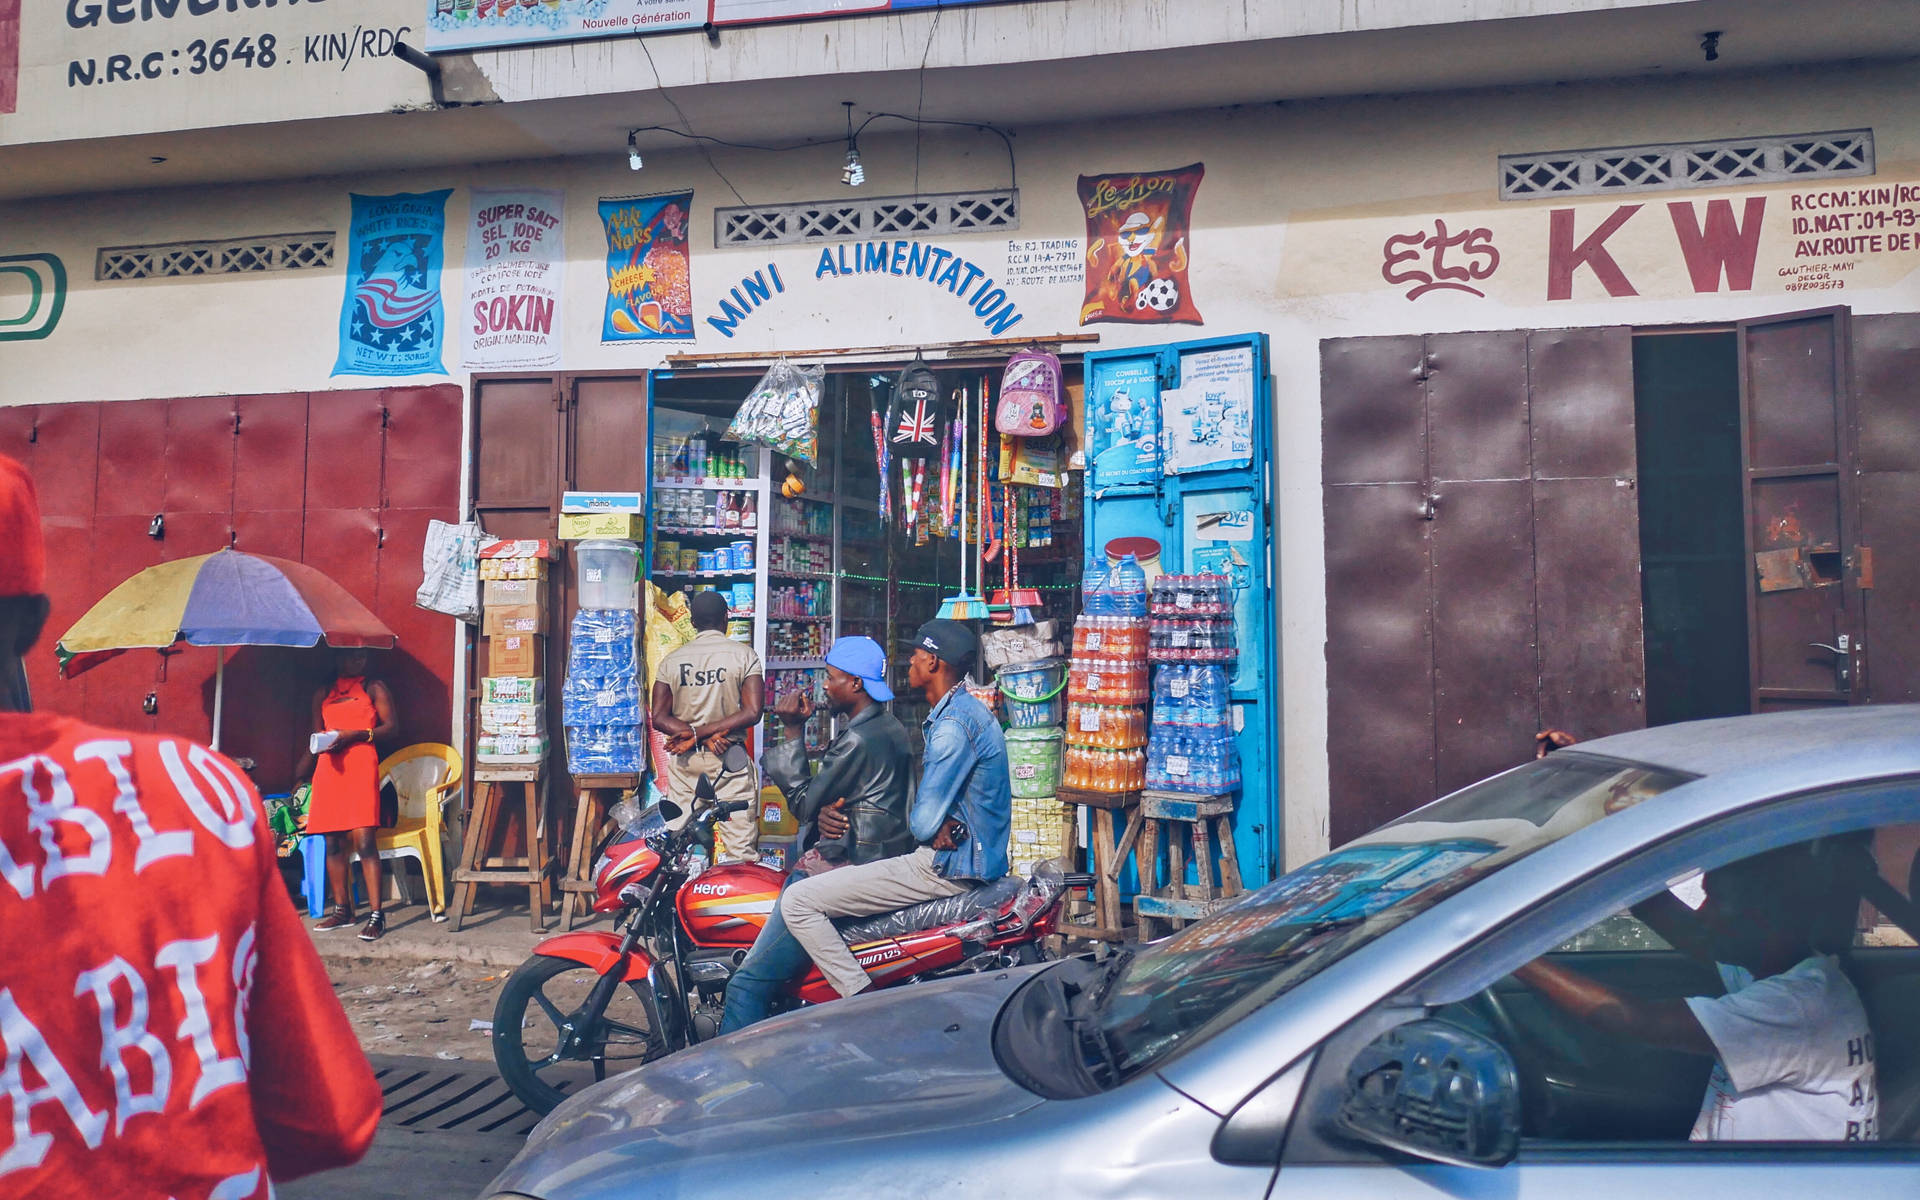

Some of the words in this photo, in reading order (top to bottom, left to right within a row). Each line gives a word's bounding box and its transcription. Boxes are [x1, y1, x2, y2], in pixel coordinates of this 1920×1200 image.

[582, 16, 628, 29] Nouvelle
[632, 10, 691, 25] Génération
[369, 203, 399, 219] LONG
[477, 204, 524, 228] SUPER
[527, 206, 559, 229] SALT
[482, 224, 507, 244] SEL
[513, 222, 543, 242] IODE
[1887, 233, 1910, 251] DE
[485, 243, 500, 260] 20
[510, 240, 531, 253] KG
[1040, 240, 1078, 250] TRADING
[1382, 218, 1500, 288] Ets
[614, 272, 645, 288] CHEESE
[1798, 273, 1831, 282] DECOR
[706, 263, 785, 338] MINI
[816, 240, 1024, 336] ALIMENTATION
[473, 295, 554, 335] SOKIN
[356, 346, 374, 358] NET
[679, 663, 727, 687] F.SEC
